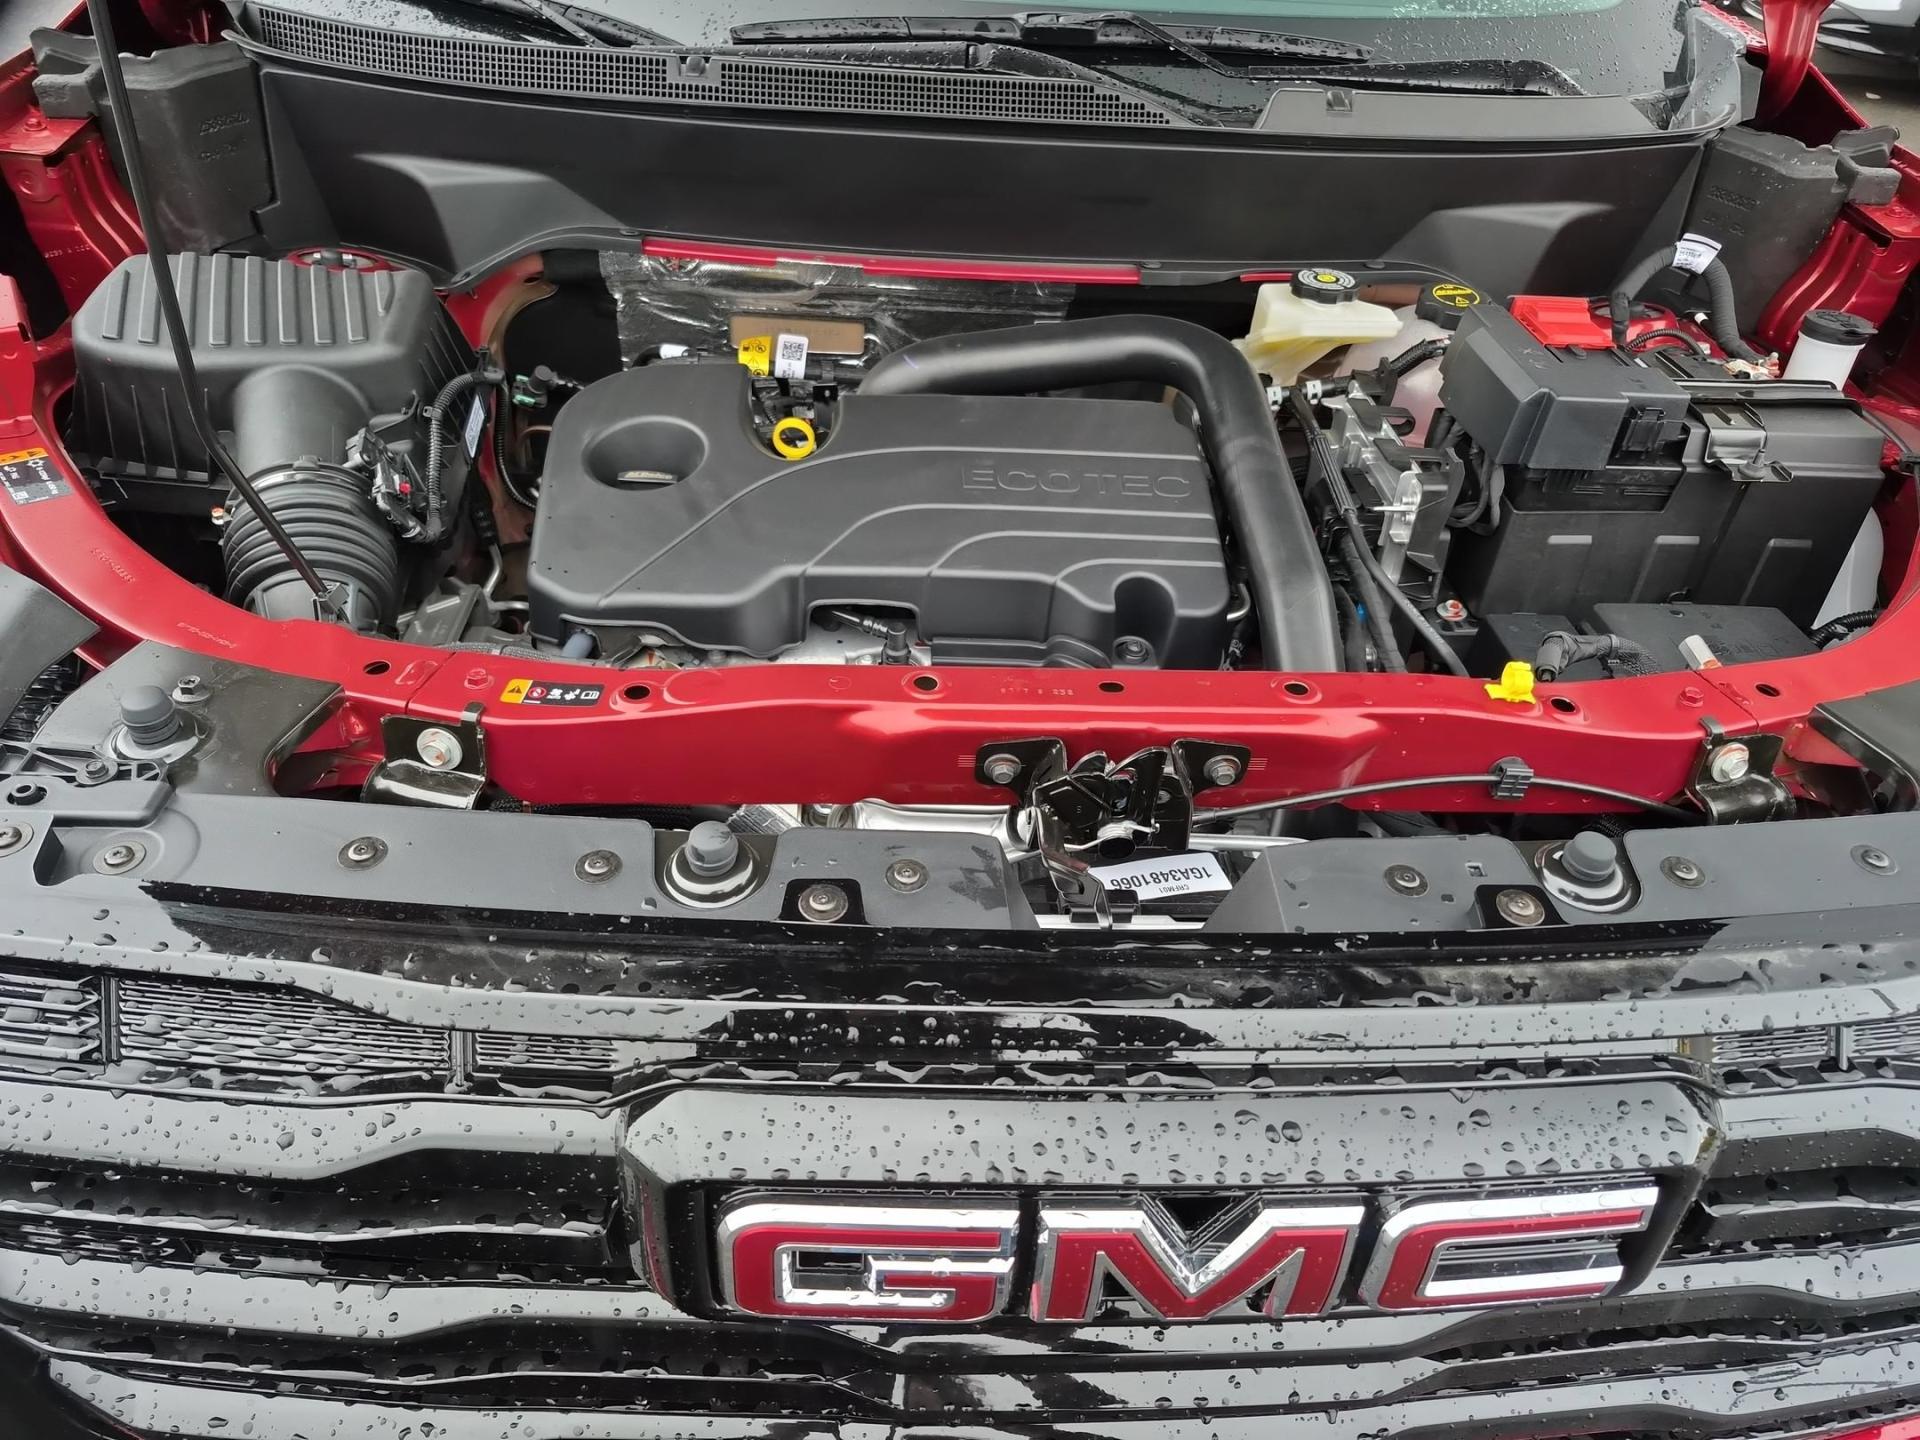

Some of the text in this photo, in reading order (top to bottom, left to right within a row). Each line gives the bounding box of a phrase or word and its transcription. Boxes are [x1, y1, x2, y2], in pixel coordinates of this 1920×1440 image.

[961, 466, 1192, 498] ECOTEC
[1110, 866, 1213, 890] 1GA3481066
[716, 1185, 1659, 1323] GMC
